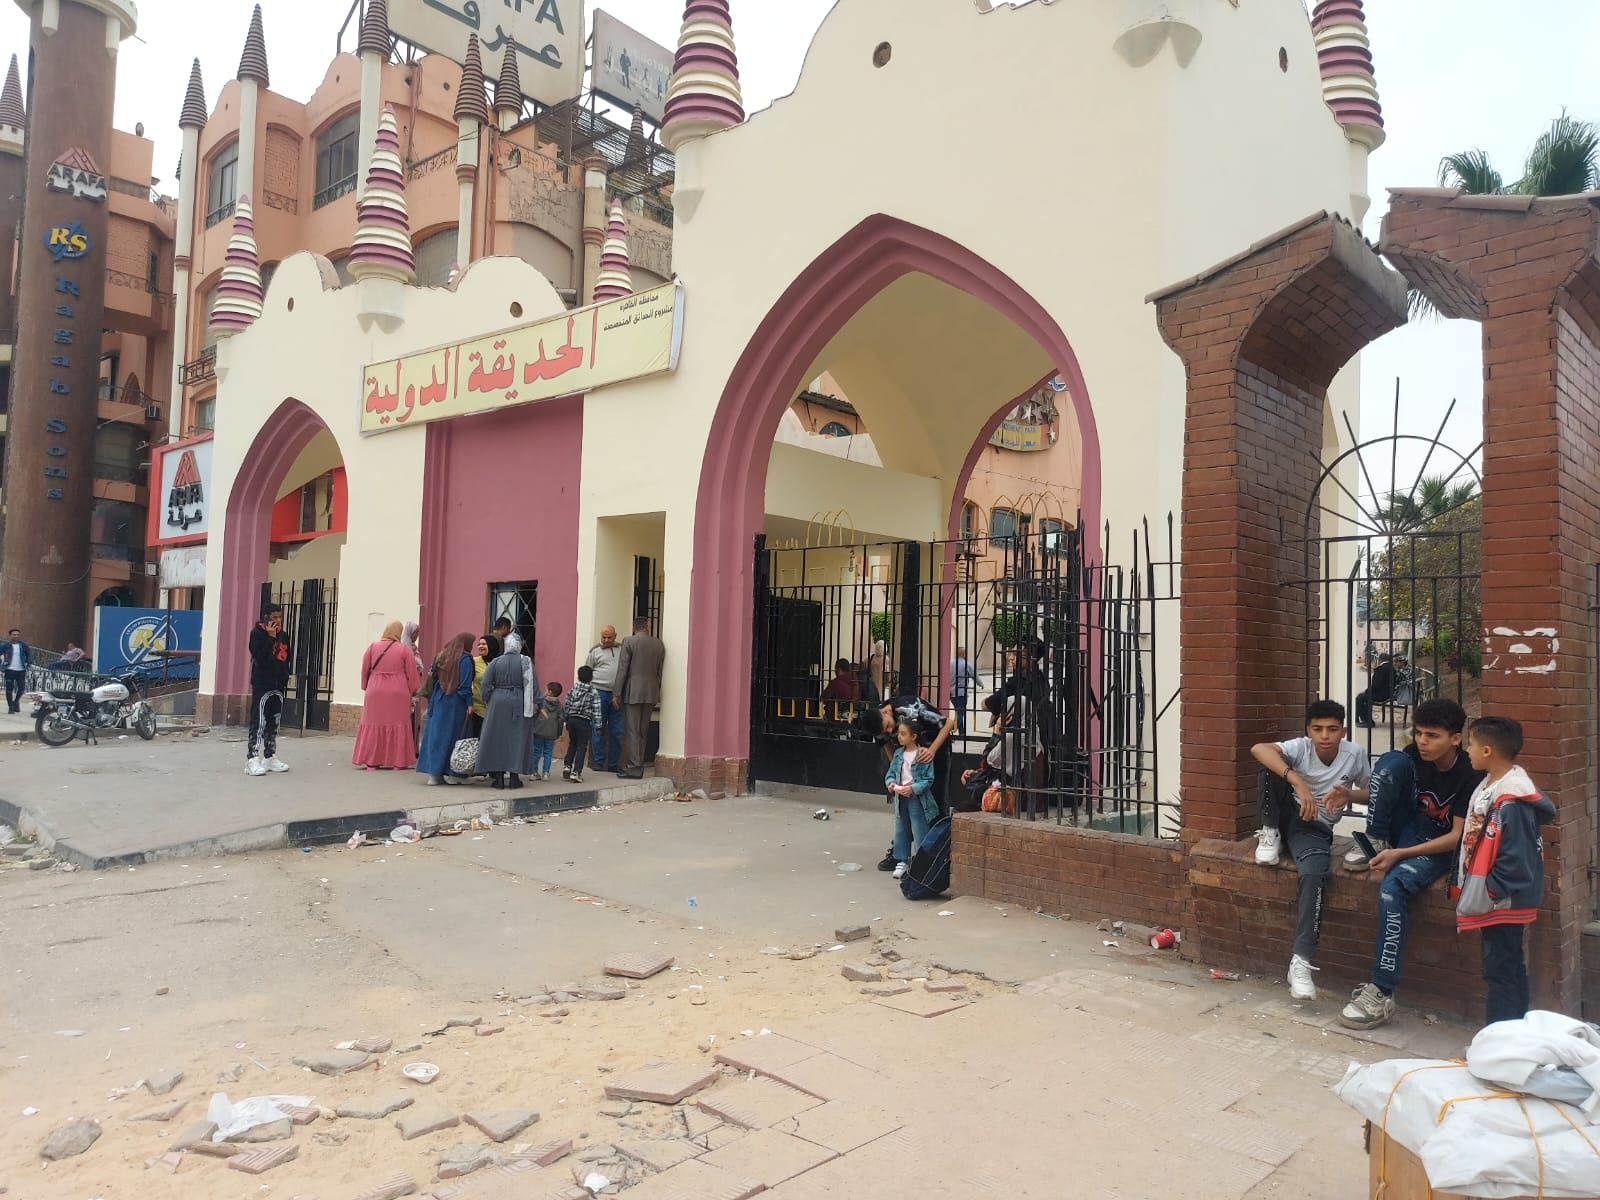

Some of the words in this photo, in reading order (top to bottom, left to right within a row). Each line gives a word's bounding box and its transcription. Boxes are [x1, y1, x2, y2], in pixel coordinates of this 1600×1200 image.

[47, 163, 107, 191] ARAFA
[50, 227, 88, 252] RS
[654, 304, 673, 319] مشروع
[50, 275, 80, 396] Ragab
[468, 306, 599, 400] الحديقة
[366, 344, 461, 424] الدولية
[44, 417, 68, 499] Sons
[168, 483, 204, 507] ARAFA
[167, 506, 203, 531] عرفة
[1380, 910, 1401, 972] MONCLER
